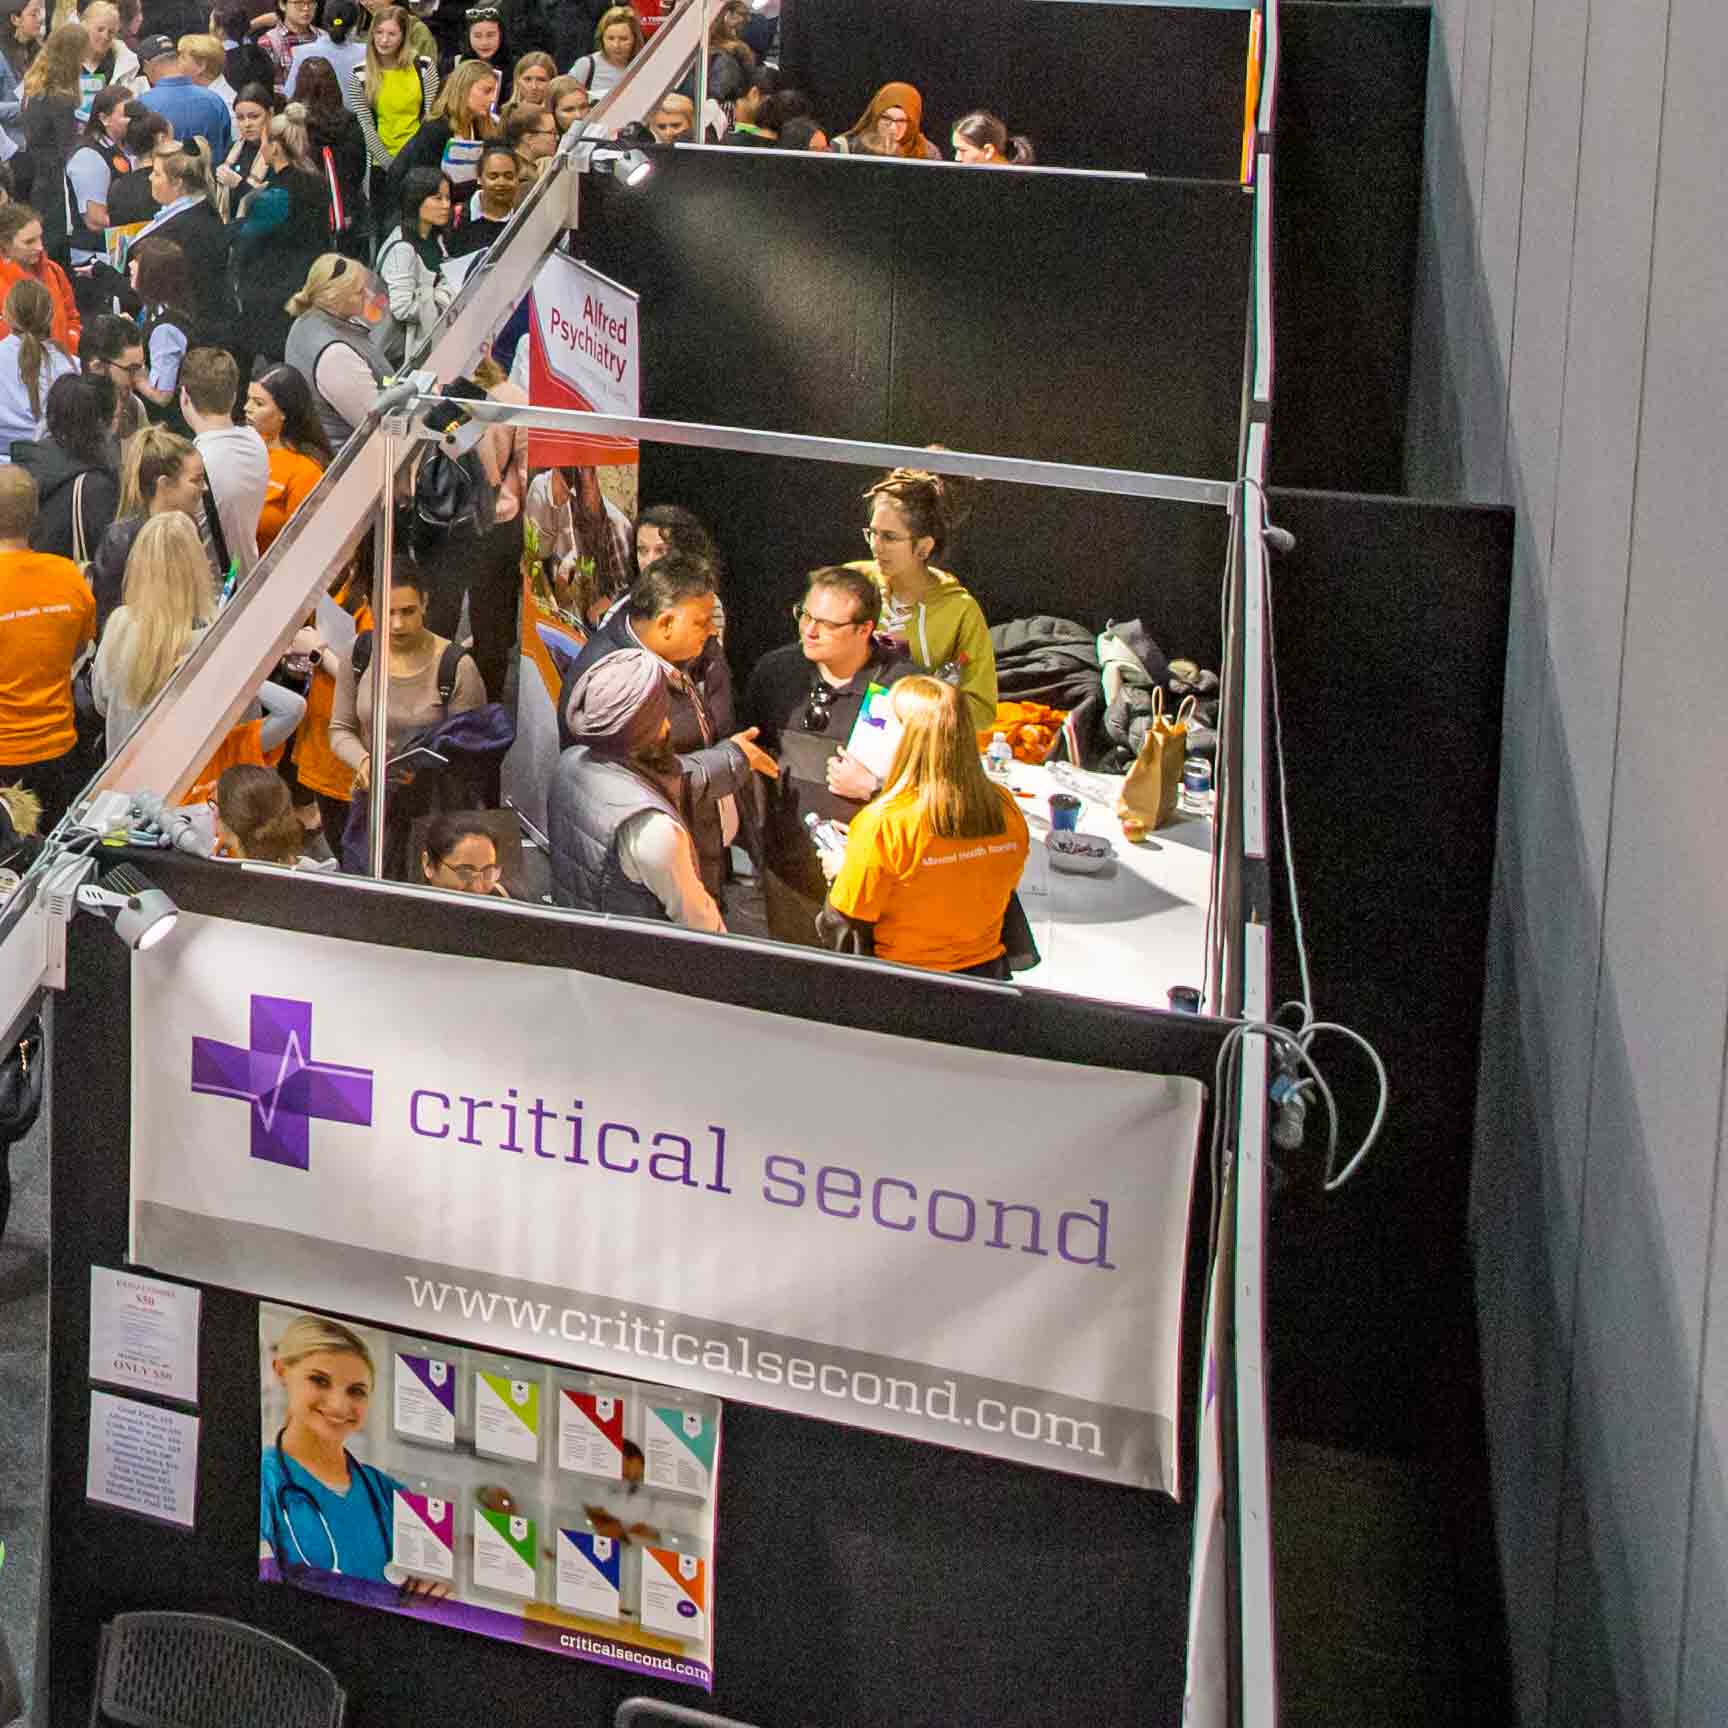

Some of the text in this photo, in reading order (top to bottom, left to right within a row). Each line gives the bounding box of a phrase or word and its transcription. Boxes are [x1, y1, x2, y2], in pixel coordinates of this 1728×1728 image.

[551, 307, 627, 383] Psychiatry
[583, 295, 628, 345] Alfred
[408, 1087, 1118, 1271] critical second
[404, 1273, 1106, 1457] www.criticalsecond.com
[559, 1632, 710, 1683] criticalsecond.com
